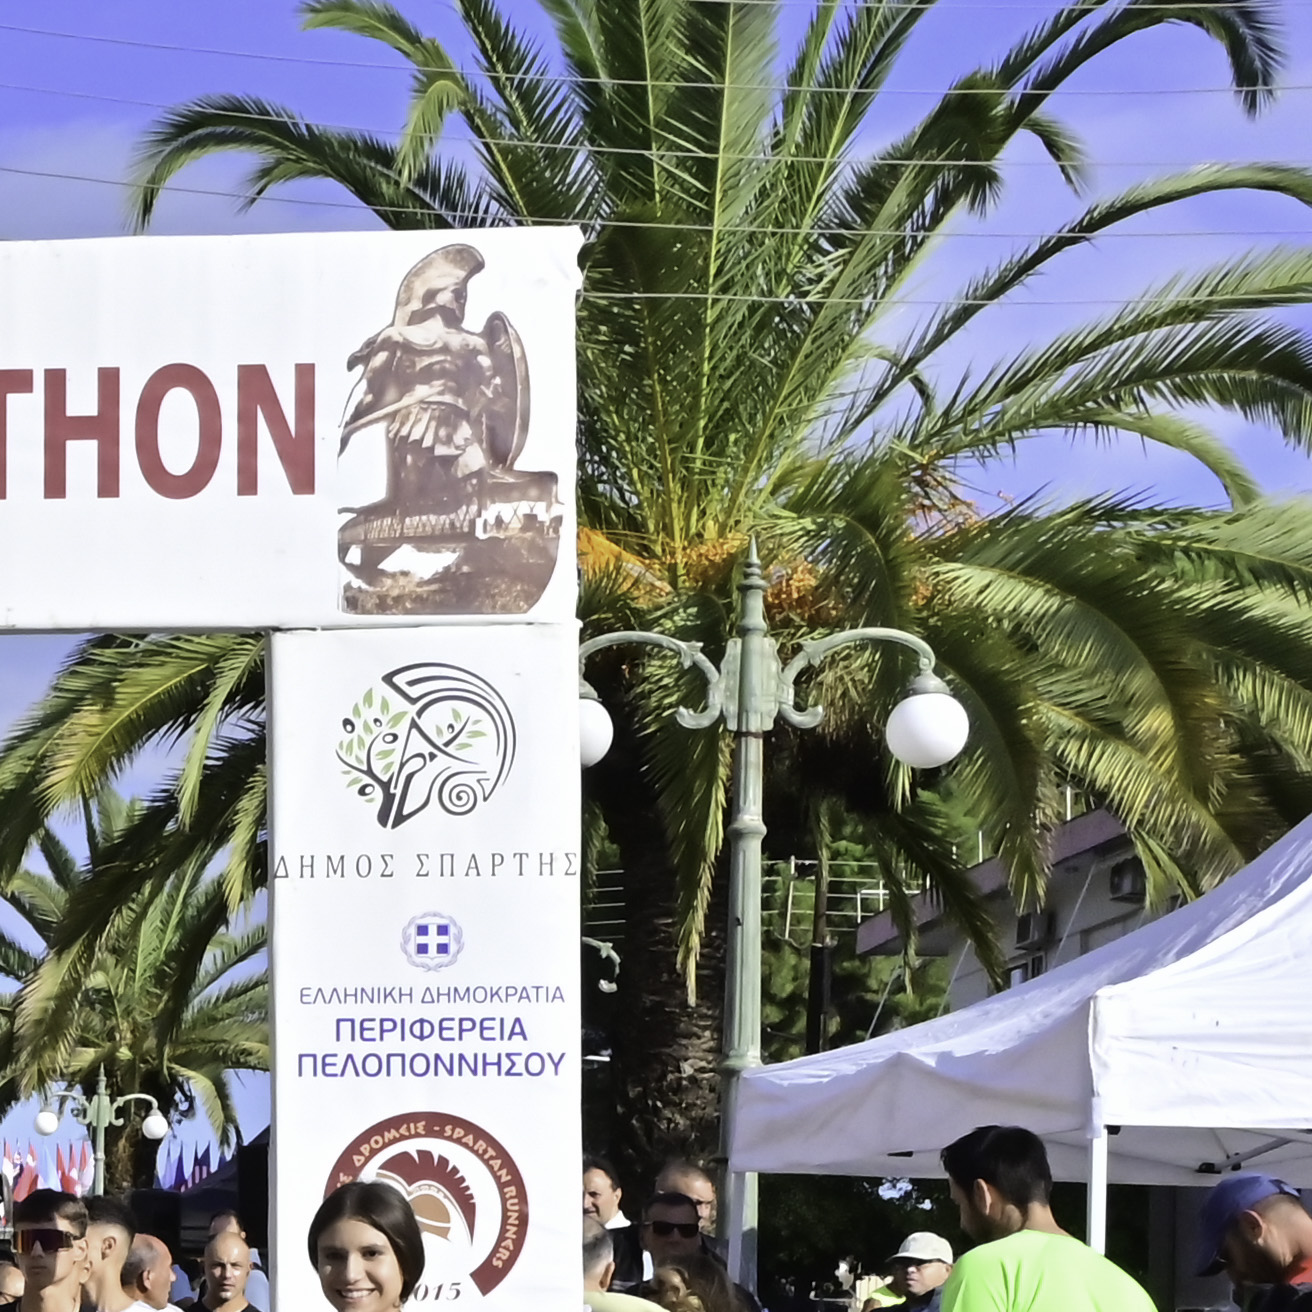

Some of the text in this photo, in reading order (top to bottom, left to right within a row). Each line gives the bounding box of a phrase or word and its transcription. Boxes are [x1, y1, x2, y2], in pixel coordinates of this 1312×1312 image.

[273, 852, 578, 879] ΔΗΜΟΣ ΣΠΑΡΤΗΣ
[299, 985, 566, 1006] ΕΛΛΗΝΙΚΗ ΔΗΜΟΚΡΑΤΙΑ
[335, 1017, 529, 1043] ΠΕΡΙΦΕΡΕΙΑ
[297, 1051, 567, 1078] ΠΕΛΟΠΟΝΝΗΣΟΥ
[443, 1124, 521, 1270] SPARTAN RUNNERS
[412, 1282, 462, 1302] 015
